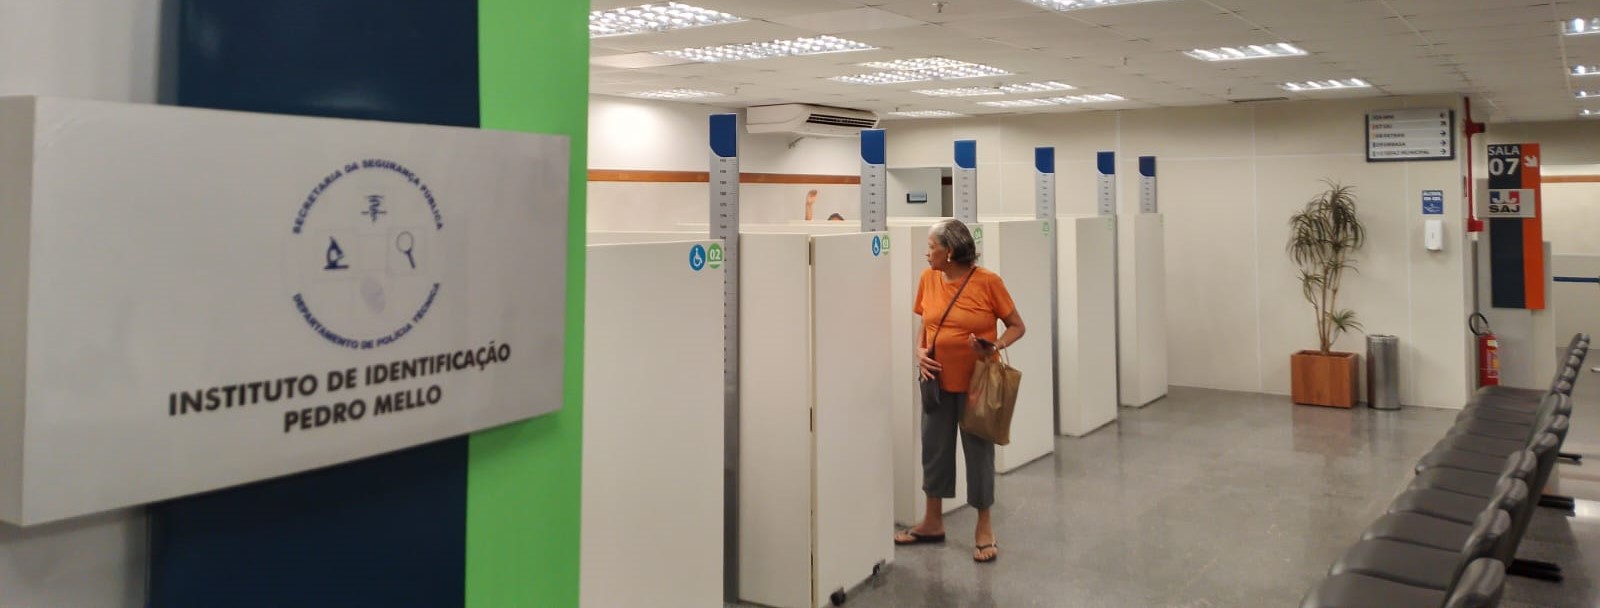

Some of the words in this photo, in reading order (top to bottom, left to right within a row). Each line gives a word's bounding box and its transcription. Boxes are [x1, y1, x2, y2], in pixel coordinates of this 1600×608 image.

[1488, 145, 1520, 156] SALA
[1489, 158, 1520, 176] 07
[292, 169, 343, 235] SECRETARIA
[344, 161, 360, 174] DA
[361, 158, 420, 187] SEGURANÇA
[1489, 205, 1520, 213] SAJ
[710, 249, 721, 261] 02
[292, 292, 360, 350] DEPARTAMENTO
[359, 339, 375, 350] DE
[168, 373, 319, 417] INSTITUTO
[326, 367, 358, 391] DE
[365, 340, 512, 386] IDENTIFICAÇÃO
[283, 398, 367, 434] PEDRO
[373, 384, 443, 417] MELLO
